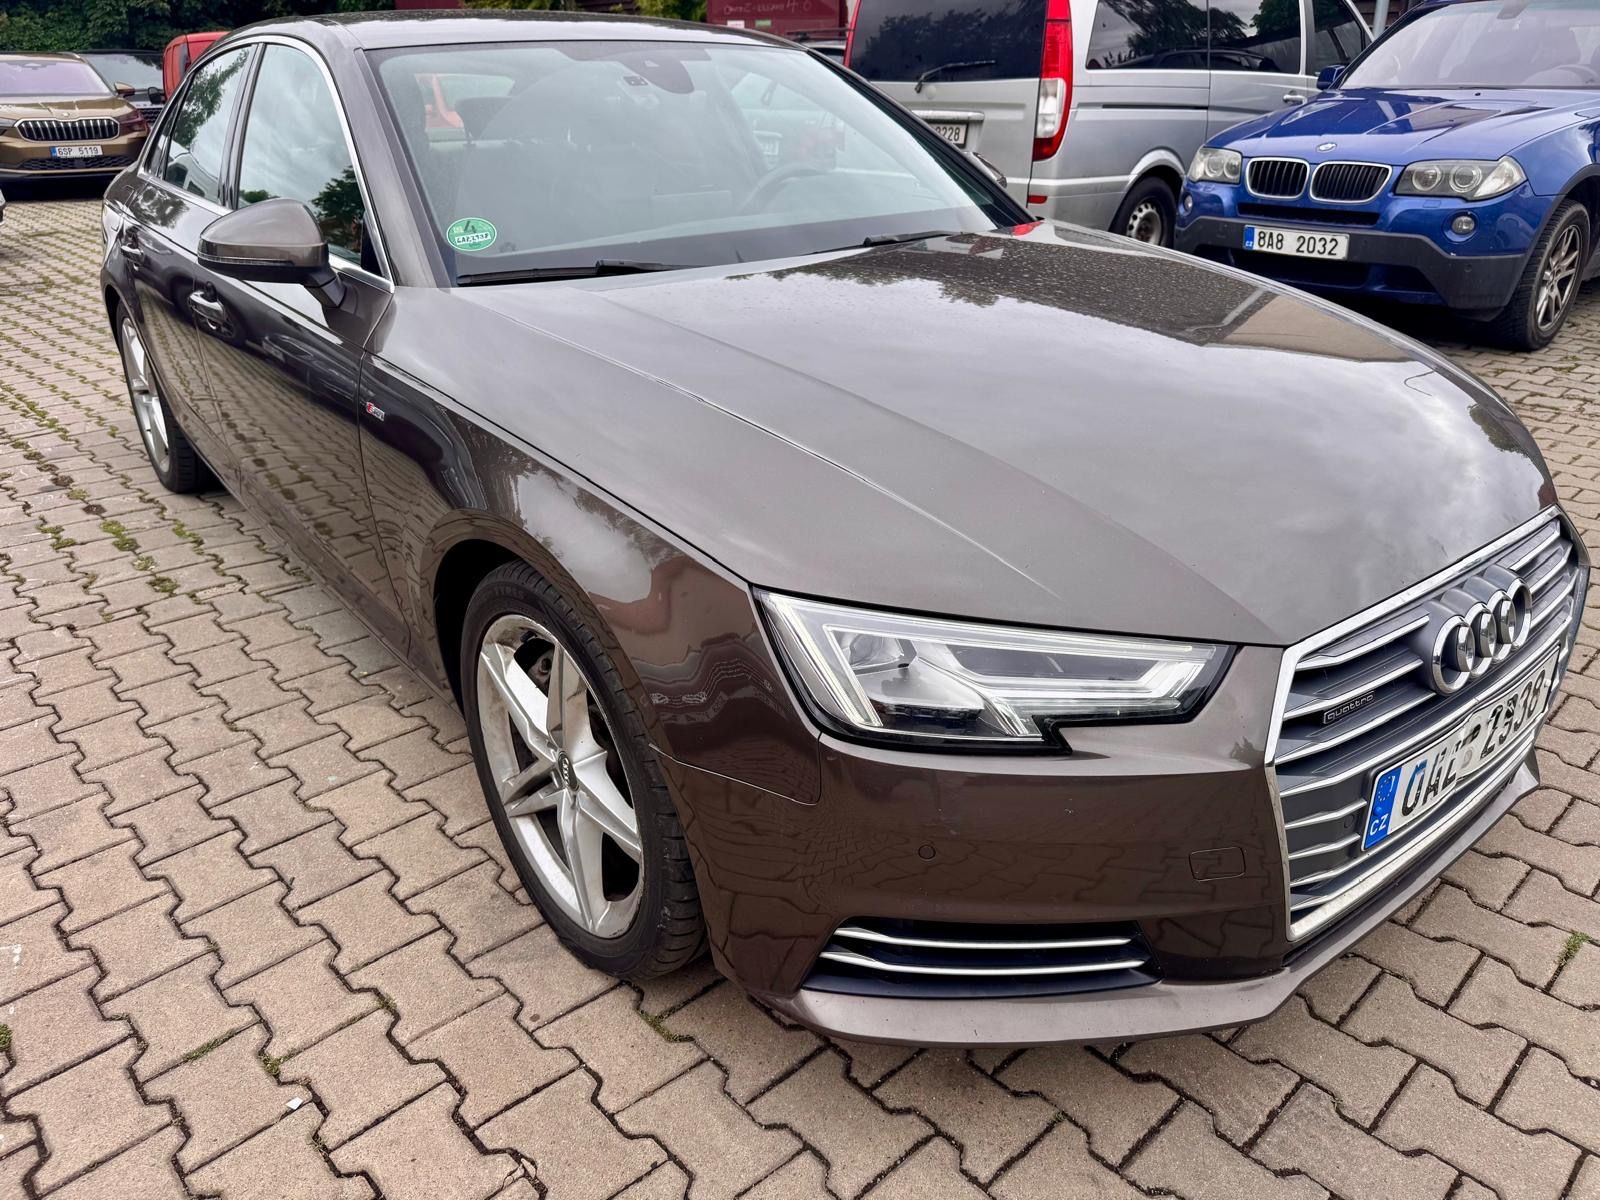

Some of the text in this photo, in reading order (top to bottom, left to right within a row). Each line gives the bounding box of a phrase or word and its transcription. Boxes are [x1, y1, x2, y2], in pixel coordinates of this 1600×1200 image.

[78, 146, 99, 155] 5119
[1257, 230, 1284, 251] 8A8
[1296, 235, 1339, 257] 2032
[1327, 694, 1374, 721] quattro
[1369, 813, 1389, 836] CZ
